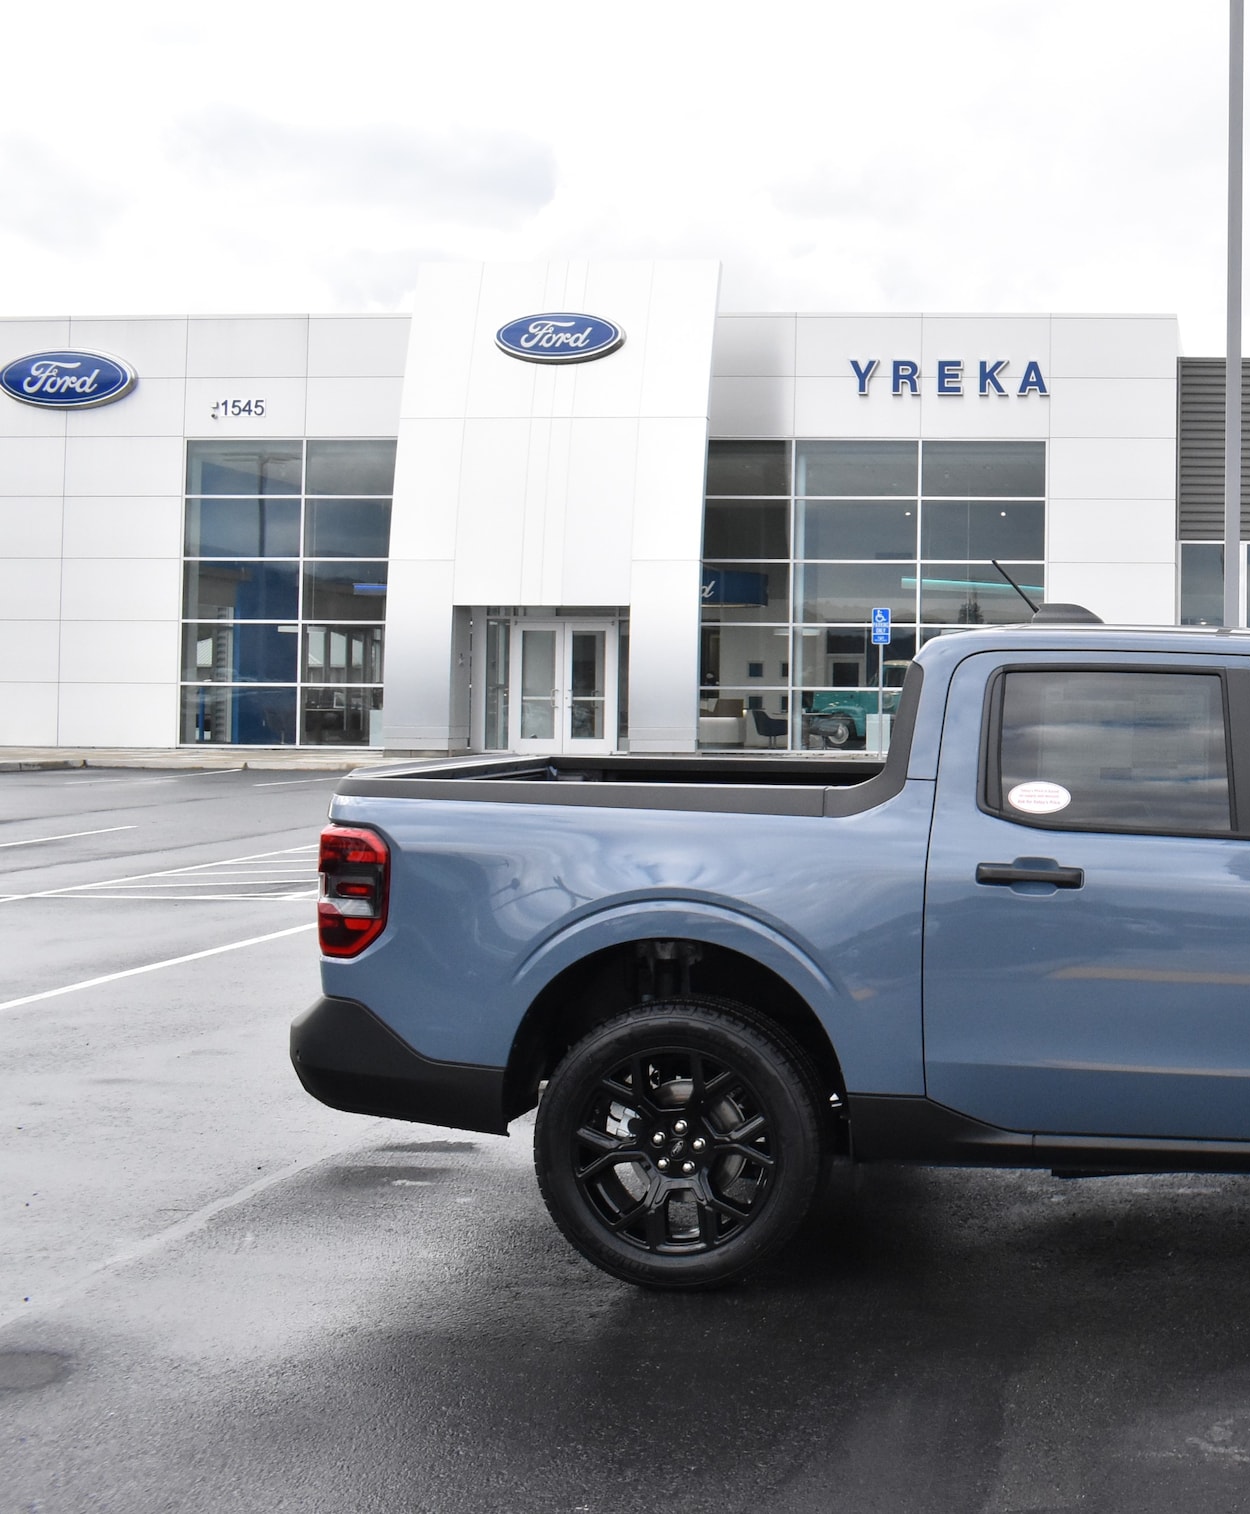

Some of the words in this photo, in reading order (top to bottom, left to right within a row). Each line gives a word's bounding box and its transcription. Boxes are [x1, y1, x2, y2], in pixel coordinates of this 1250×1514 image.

[520, 320, 593, 348] Ford
[22, 360, 100, 393] Ford
[849, 359, 1050, 397] YREKA
[221, 399, 265, 416] 1545
